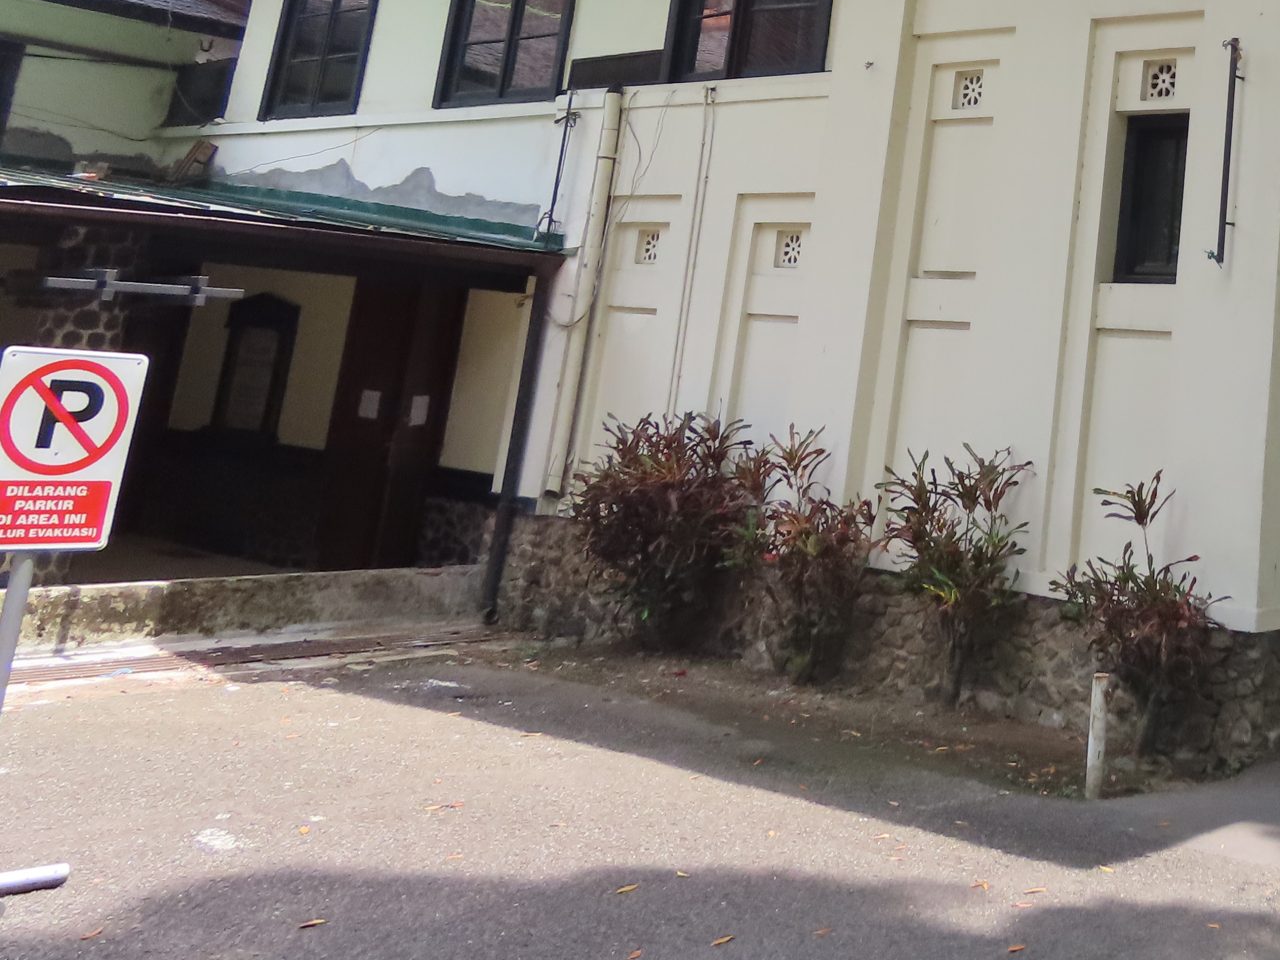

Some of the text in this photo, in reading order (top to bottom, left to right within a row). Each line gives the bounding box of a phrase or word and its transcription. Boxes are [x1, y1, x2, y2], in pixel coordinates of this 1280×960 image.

[35, 379, 105, 449] P
[6, 485, 88, 497] DILARANG
[14, 500, 74, 511] PARKIR
[16, 514, 59, 525] AREA
[63, 514, 87, 525] INI
[28, 527, 97, 538] EVAKUASI)
